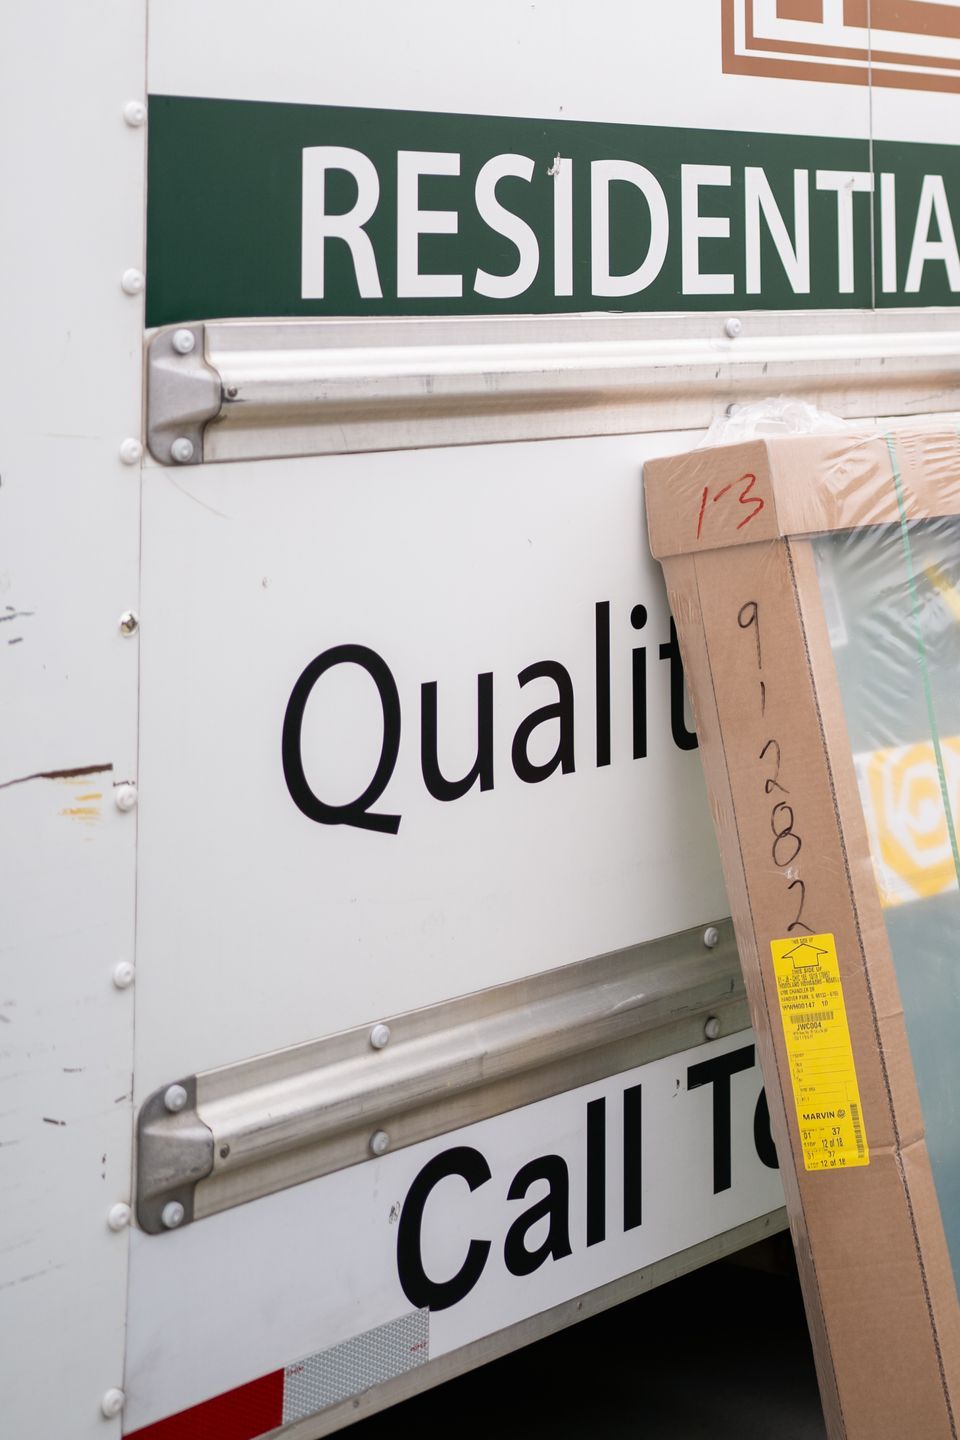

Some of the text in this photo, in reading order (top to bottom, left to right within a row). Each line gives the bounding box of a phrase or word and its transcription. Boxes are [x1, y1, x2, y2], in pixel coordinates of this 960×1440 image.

[802, 1111, 835, 1121] MARVIN
[832, 1127, 841, 1136] 37
[396, 1083, 643, 1312] Call
